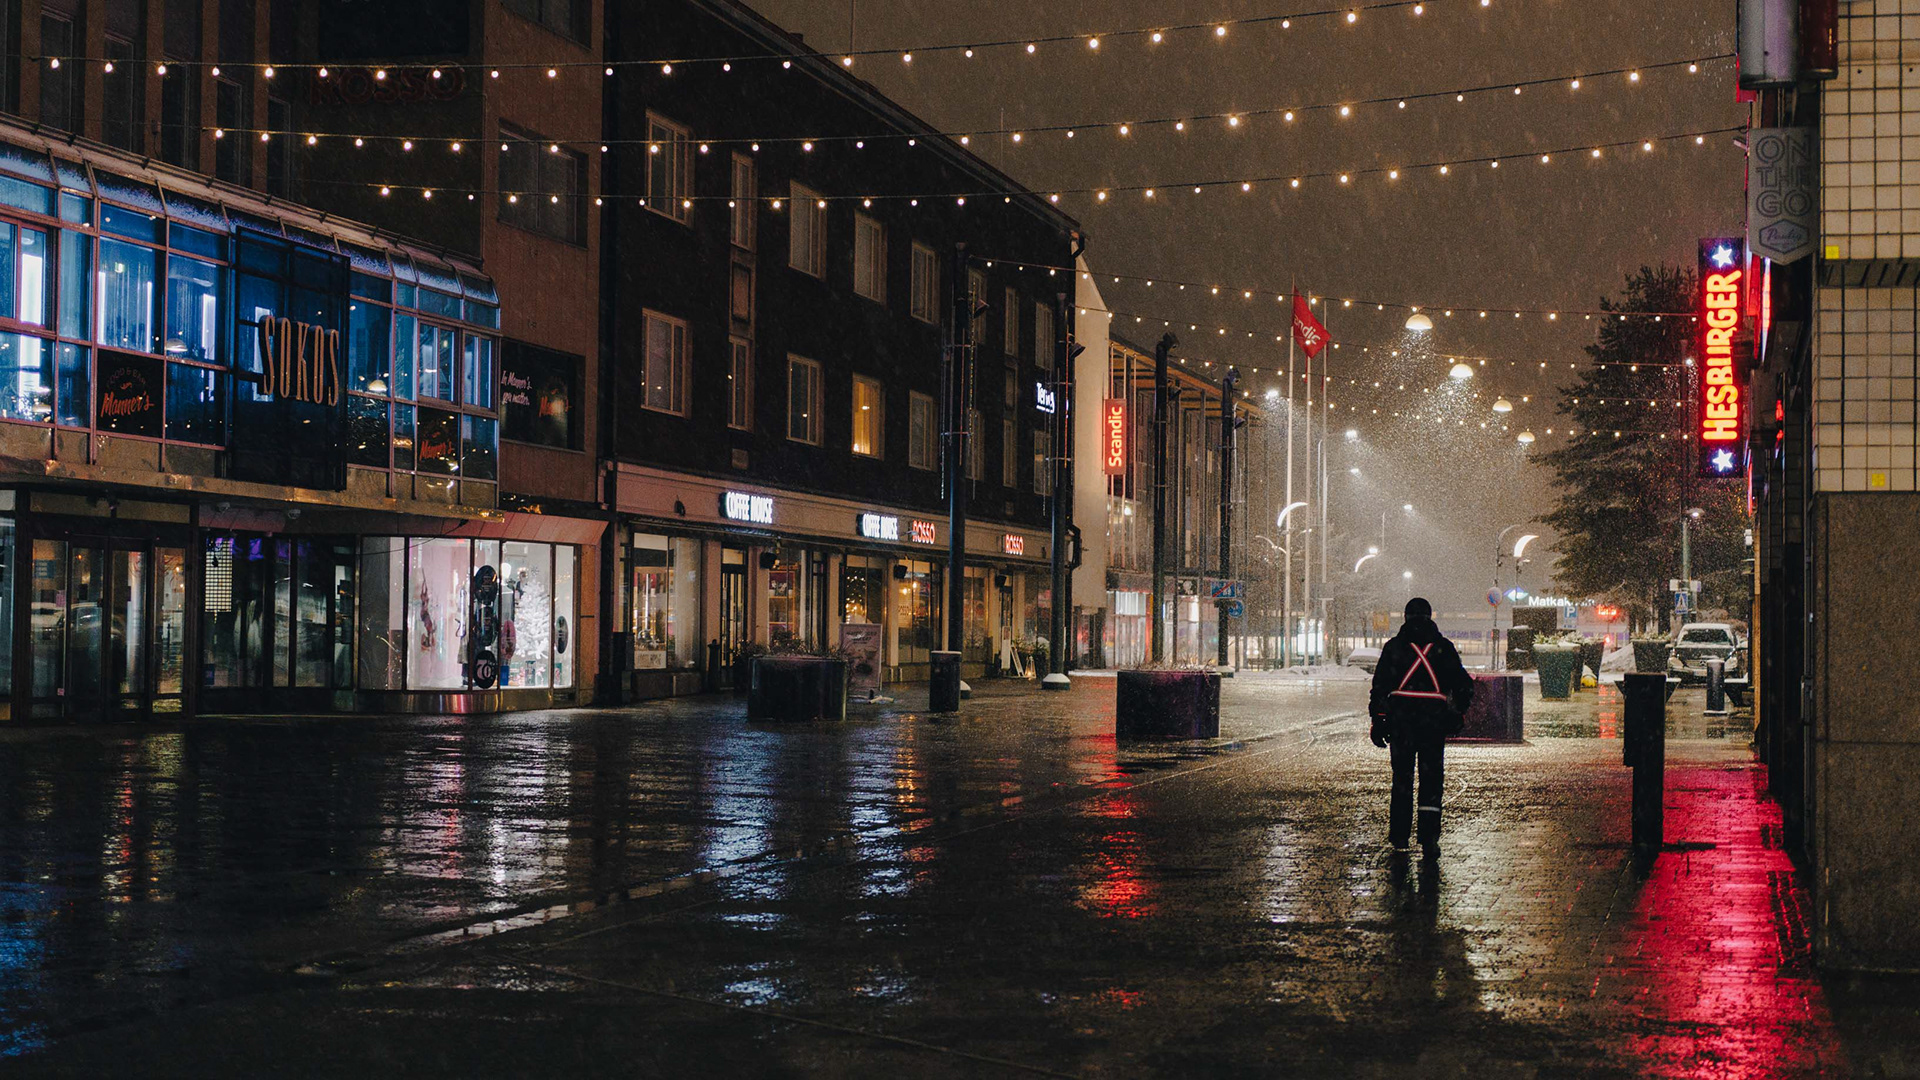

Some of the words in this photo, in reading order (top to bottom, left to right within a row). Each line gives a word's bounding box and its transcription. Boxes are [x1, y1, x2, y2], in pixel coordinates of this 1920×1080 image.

[309, 60, 465, 106] ROSSO
[1756, 135, 1811, 163] ON
[1756, 166, 1810, 189] THE
[1756, 190, 1812, 217] GO
[262, 315, 339, 406] SOKOS
[1703, 270, 1742, 440] HESBURGER
[101, 390, 155, 418] Manner's
[1108, 406, 1122, 467] Scandic
[726, 491, 749, 520] COFFEE
[750, 496, 773, 523] HOUSE
[862, 513, 880, 538] COFFEE
[881, 516, 898, 540] HOUSE
[912, 520, 935, 544] ROSSO
[1005, 534, 1024, 555] ROSSO
